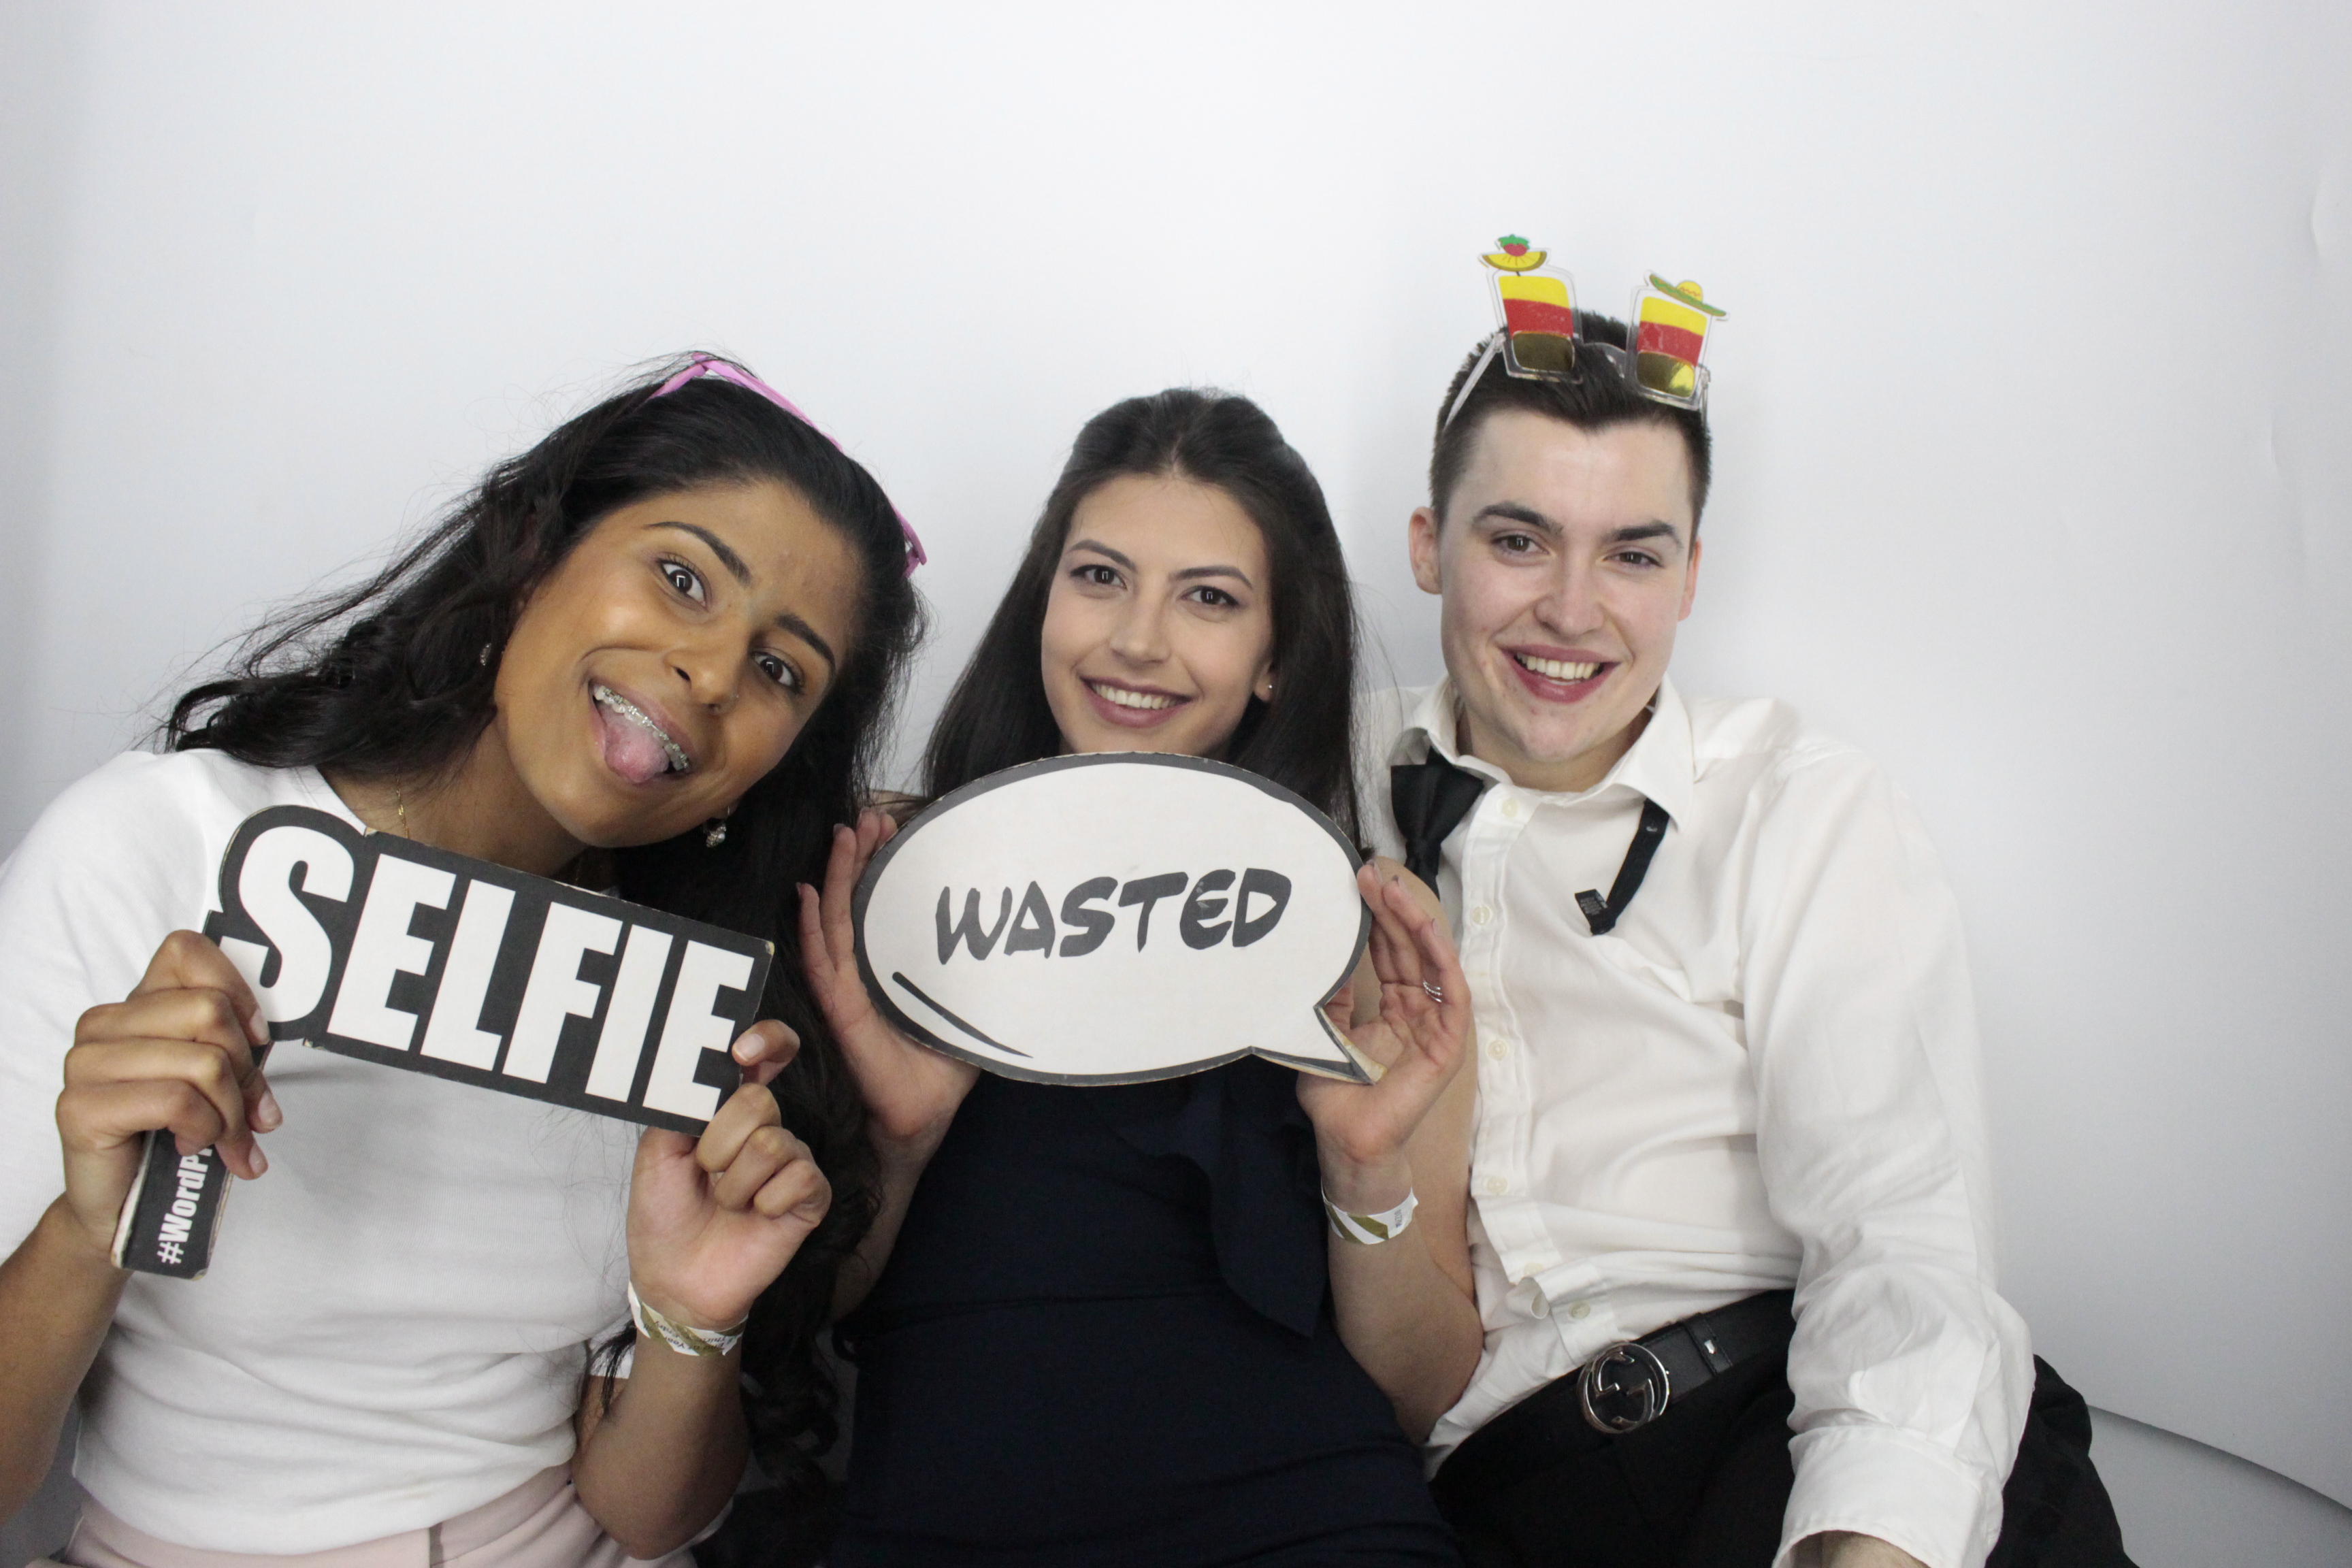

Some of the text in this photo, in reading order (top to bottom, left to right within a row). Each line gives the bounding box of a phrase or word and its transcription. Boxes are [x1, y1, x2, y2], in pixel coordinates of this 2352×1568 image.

[220, 826, 755, 1122] SELFIE
[935, 867, 1292, 965] WASTED
[157, 1148, 213, 1264] #WordP
